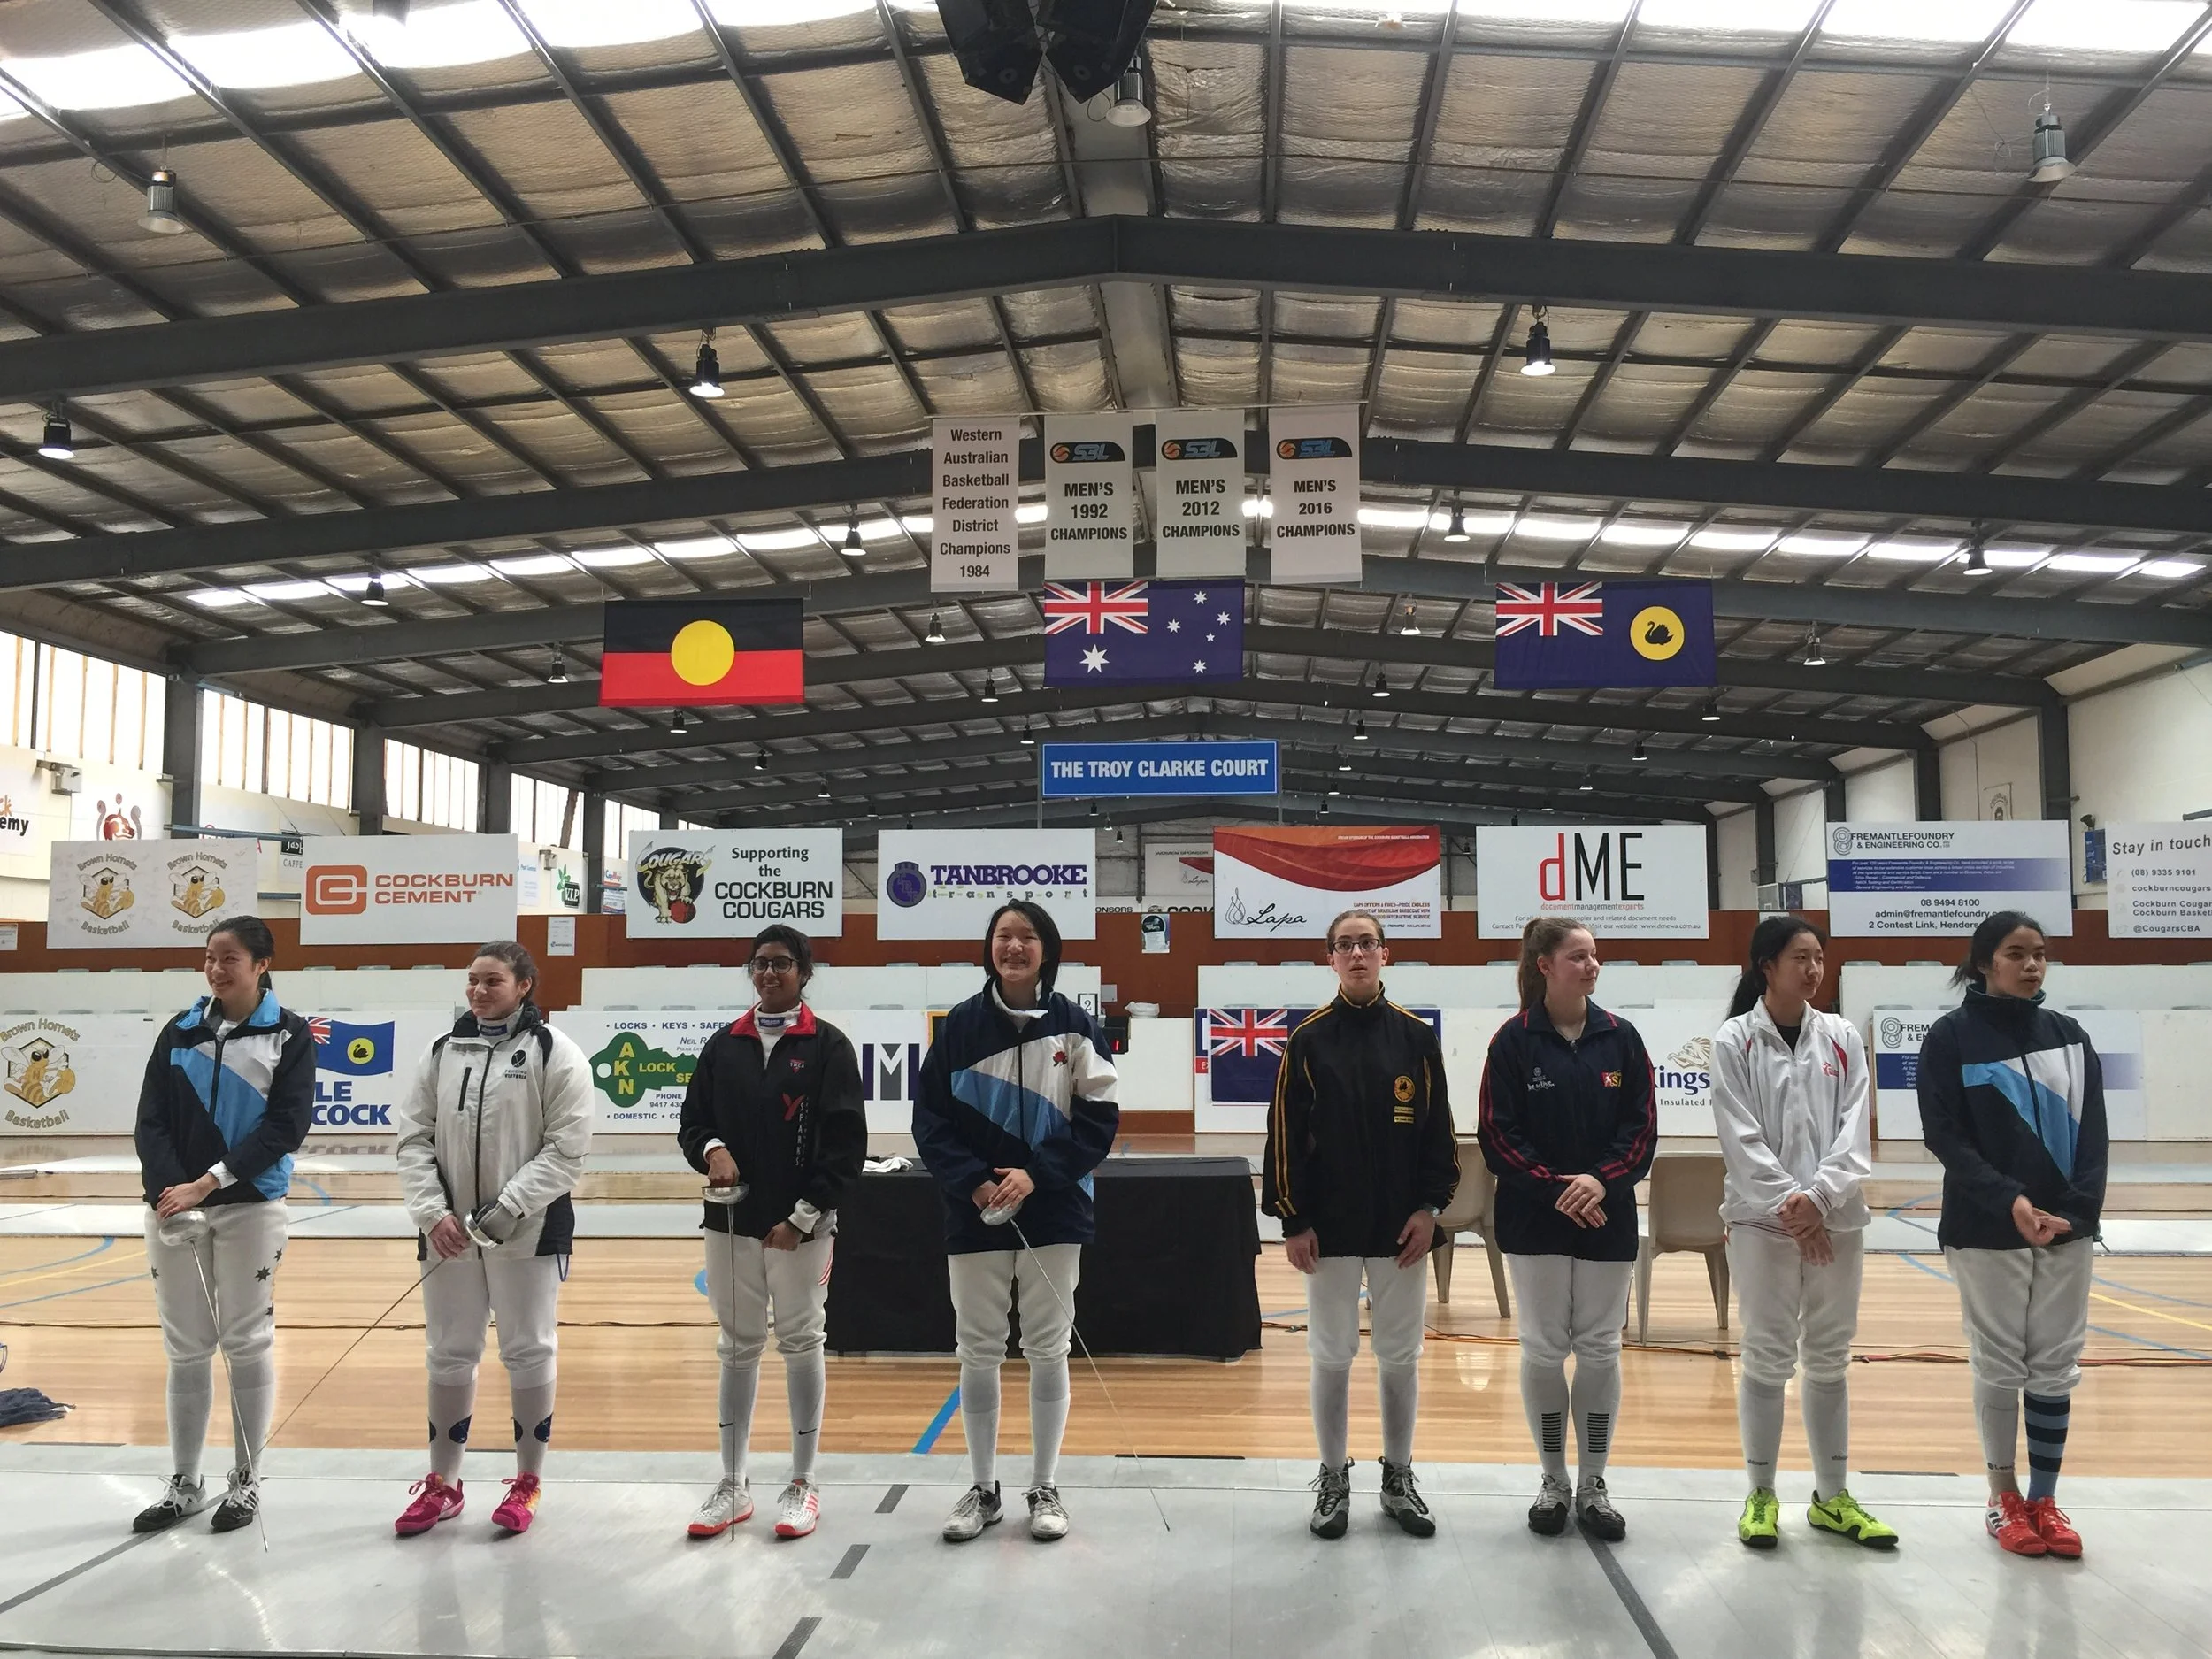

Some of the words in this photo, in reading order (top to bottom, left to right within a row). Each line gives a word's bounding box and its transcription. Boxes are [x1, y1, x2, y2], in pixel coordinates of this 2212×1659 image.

[950, 427, 1002, 442] Western
[943, 449, 1009, 465] Australian
[942, 472, 1010, 488] Basketball
[1175, 479, 1226, 495] MEN'S
[1294, 479, 1337, 494] MEN'S
[1064, 481, 1114, 497] MEN'S
[942, 495, 1010, 511] Federation
[1071, 503, 1109, 519] 1992
[1181, 501, 1220, 517] 2012
[1298, 502, 1333, 515] 2016
[952, 518, 999, 533] District
[1050, 526, 1128, 541] CHAMPIONS
[1162, 523, 1240, 538] CHAMPIONS
[1276, 523, 1356, 538] CHAMPIONS
[940, 541, 1010, 557] Champions
[960, 565, 990, 579] 1984
[1050, 760, 1084, 778] THE
[1088, 760, 1133, 778] TROY
[1137, 759, 1205, 777] CLARKE
[1210, 758, 1269, 777] COURT
[1850, 832, 1955, 841] FREMANTLEFOUNDRY
[2112, 842, 2144, 856] Stay
[2150, 840, 2163, 851] in
[2170, 834, 2211, 849] touch
[166, 854, 194, 871] Brown
[635, 841, 716, 878] COUGARS
[732, 847, 809, 862] Supporting
[77, 855, 104, 872] Brown
[758, 864, 781, 877] the
[1540, 833, 1645, 901] dME
[375, 873, 513, 887] COCKBURN
[931, 864, 1087, 885] TANBROOKE
[375, 890, 476, 904] CEMENT
[715, 881, 833, 899] COCKBURN
[723, 900, 825, 918] COUGARS
[1540, 902, 1644, 911] documentmanagementexperts
[1247, 903, 1307, 932] Lapa
[81, 919, 130, 935] Basketball
[2133, 925, 2200, 933] @CougarsCBA
[1084, 1000, 1092, 1010] 2
[0, 1021, 35, 1042] Brown
[639, 1063, 676, 1072] LOCK
[4, 1109, 70, 1129] Basketball
